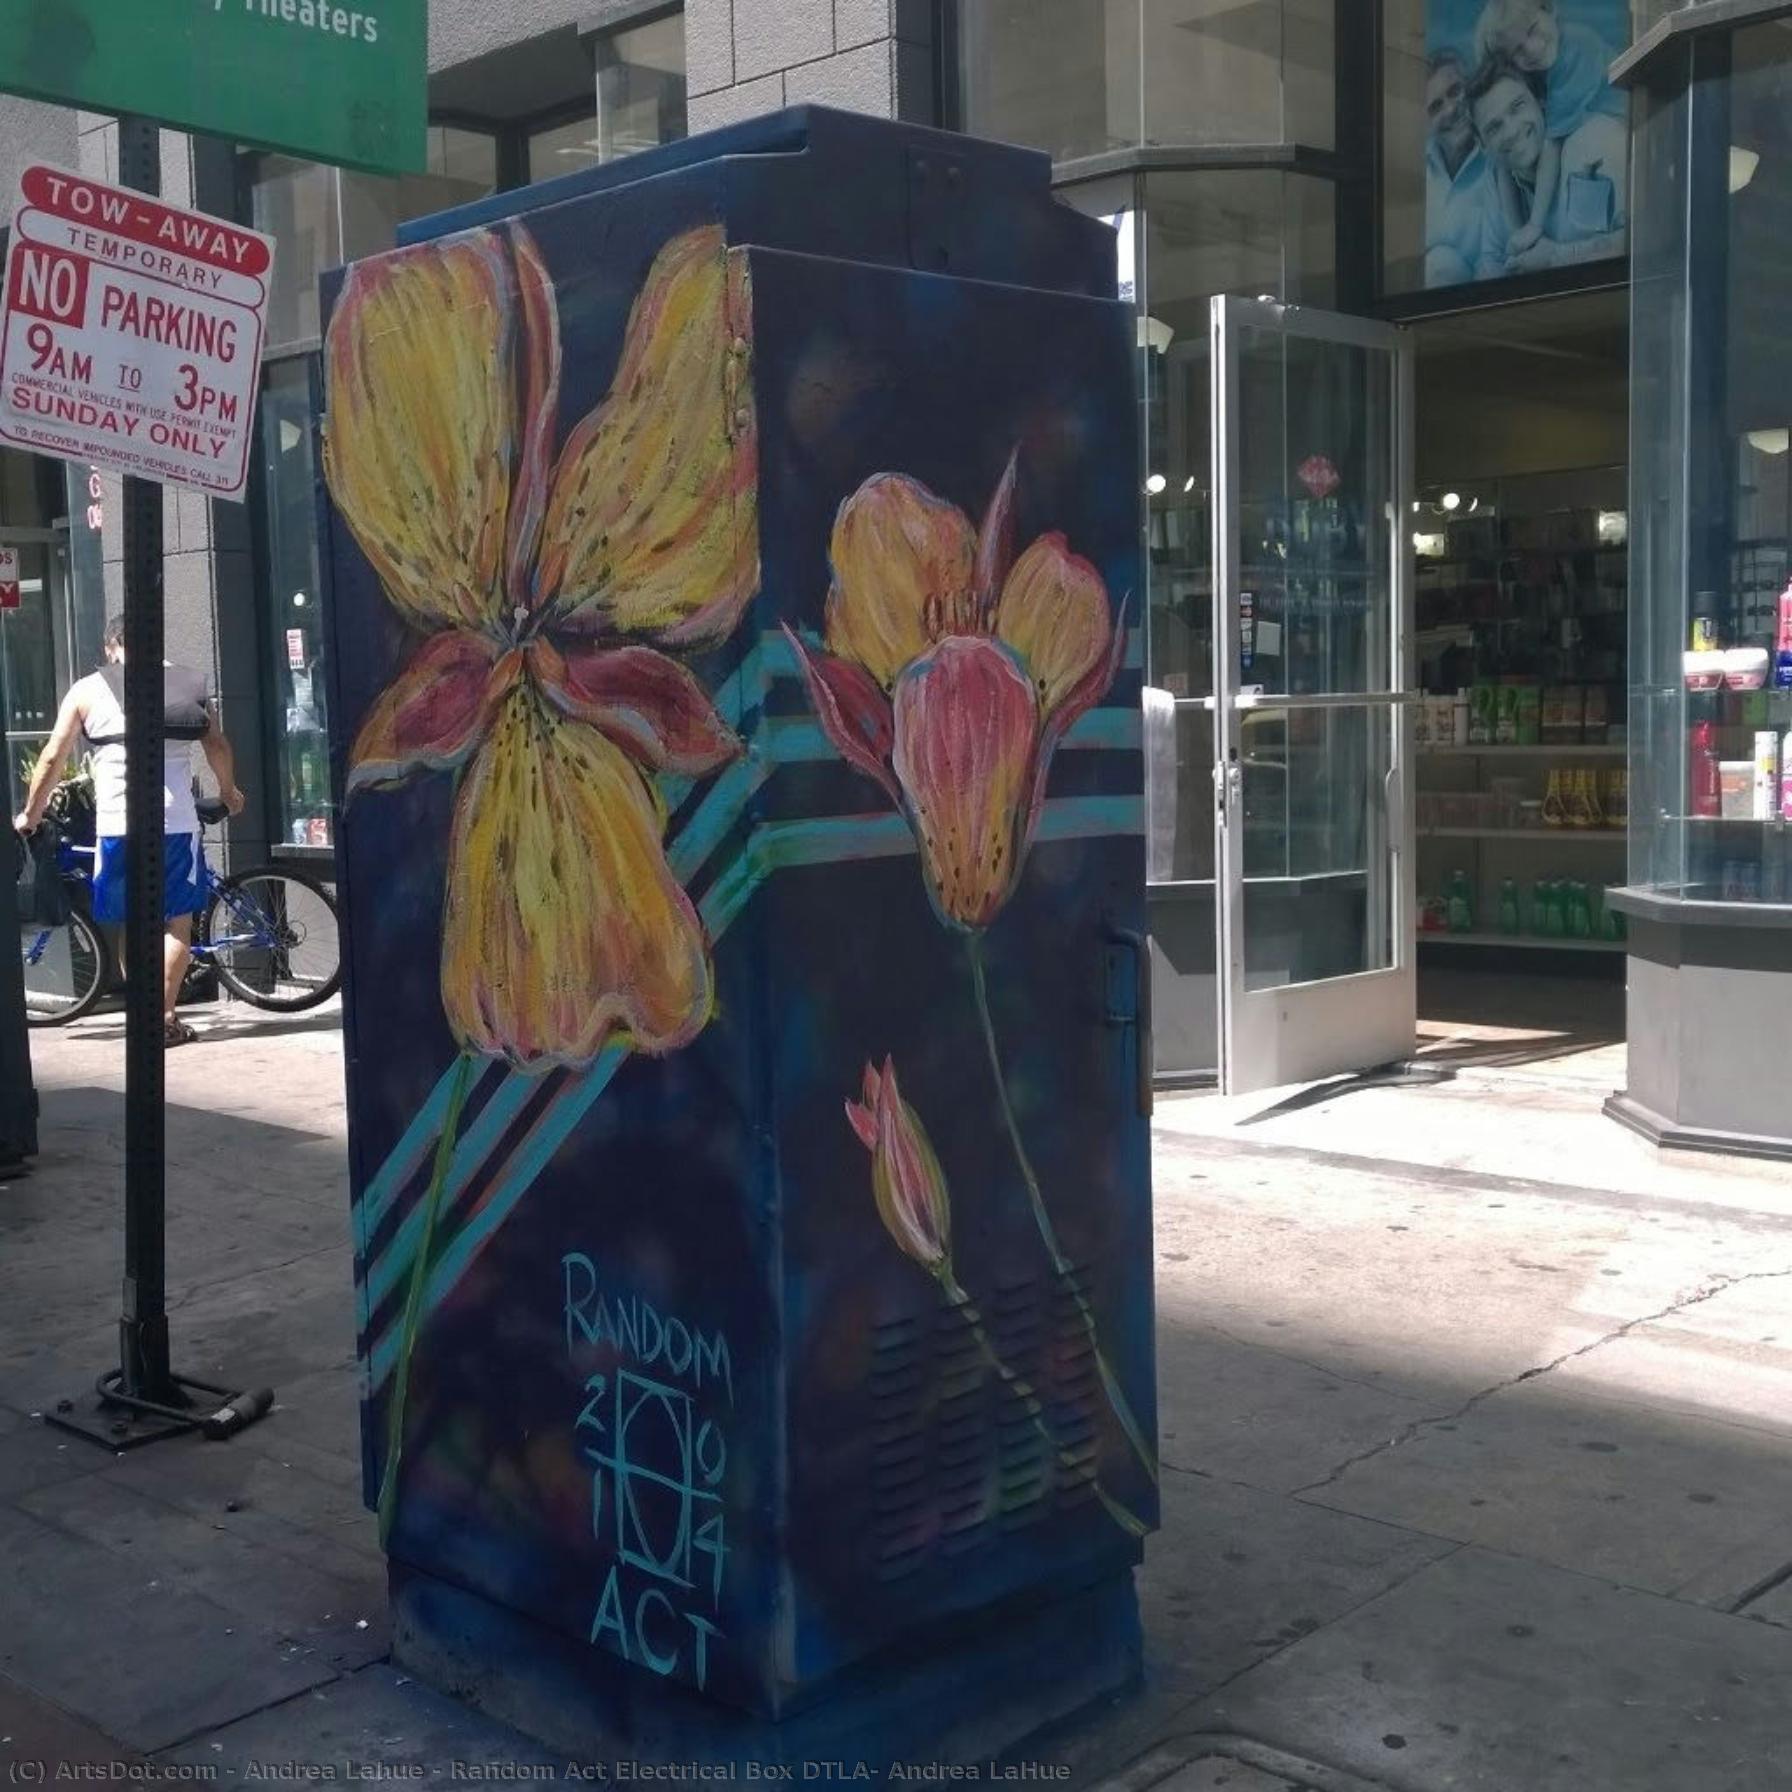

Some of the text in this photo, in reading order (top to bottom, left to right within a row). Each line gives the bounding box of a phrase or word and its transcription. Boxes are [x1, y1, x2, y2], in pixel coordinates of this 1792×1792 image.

[66, 226, 223, 289] TEMPORARY
[19, 248, 237, 363] NO PARKING
[12, 371, 74, 397] COMMERCIAL
[78, 388, 122, 409] VEHICLES
[125, 401, 147, 417] WITH
[150, 406, 167, 420] USE
[203, 421, 237, 440] EXEMPT
[27, 322, 238, 422] 9AM TO 3PM
[12, 385, 227, 459] SUNDAY ONLY
[31, 429, 80, 448] RECOVER
[83, 441, 141, 463] IMPOUNDED
[143, 456, 188, 475] VEHICLES
[190, 467, 213, 481] CALL
[561, 1251, 735, 1409] RANDOM
[590, 1564, 727, 1693] ACT
